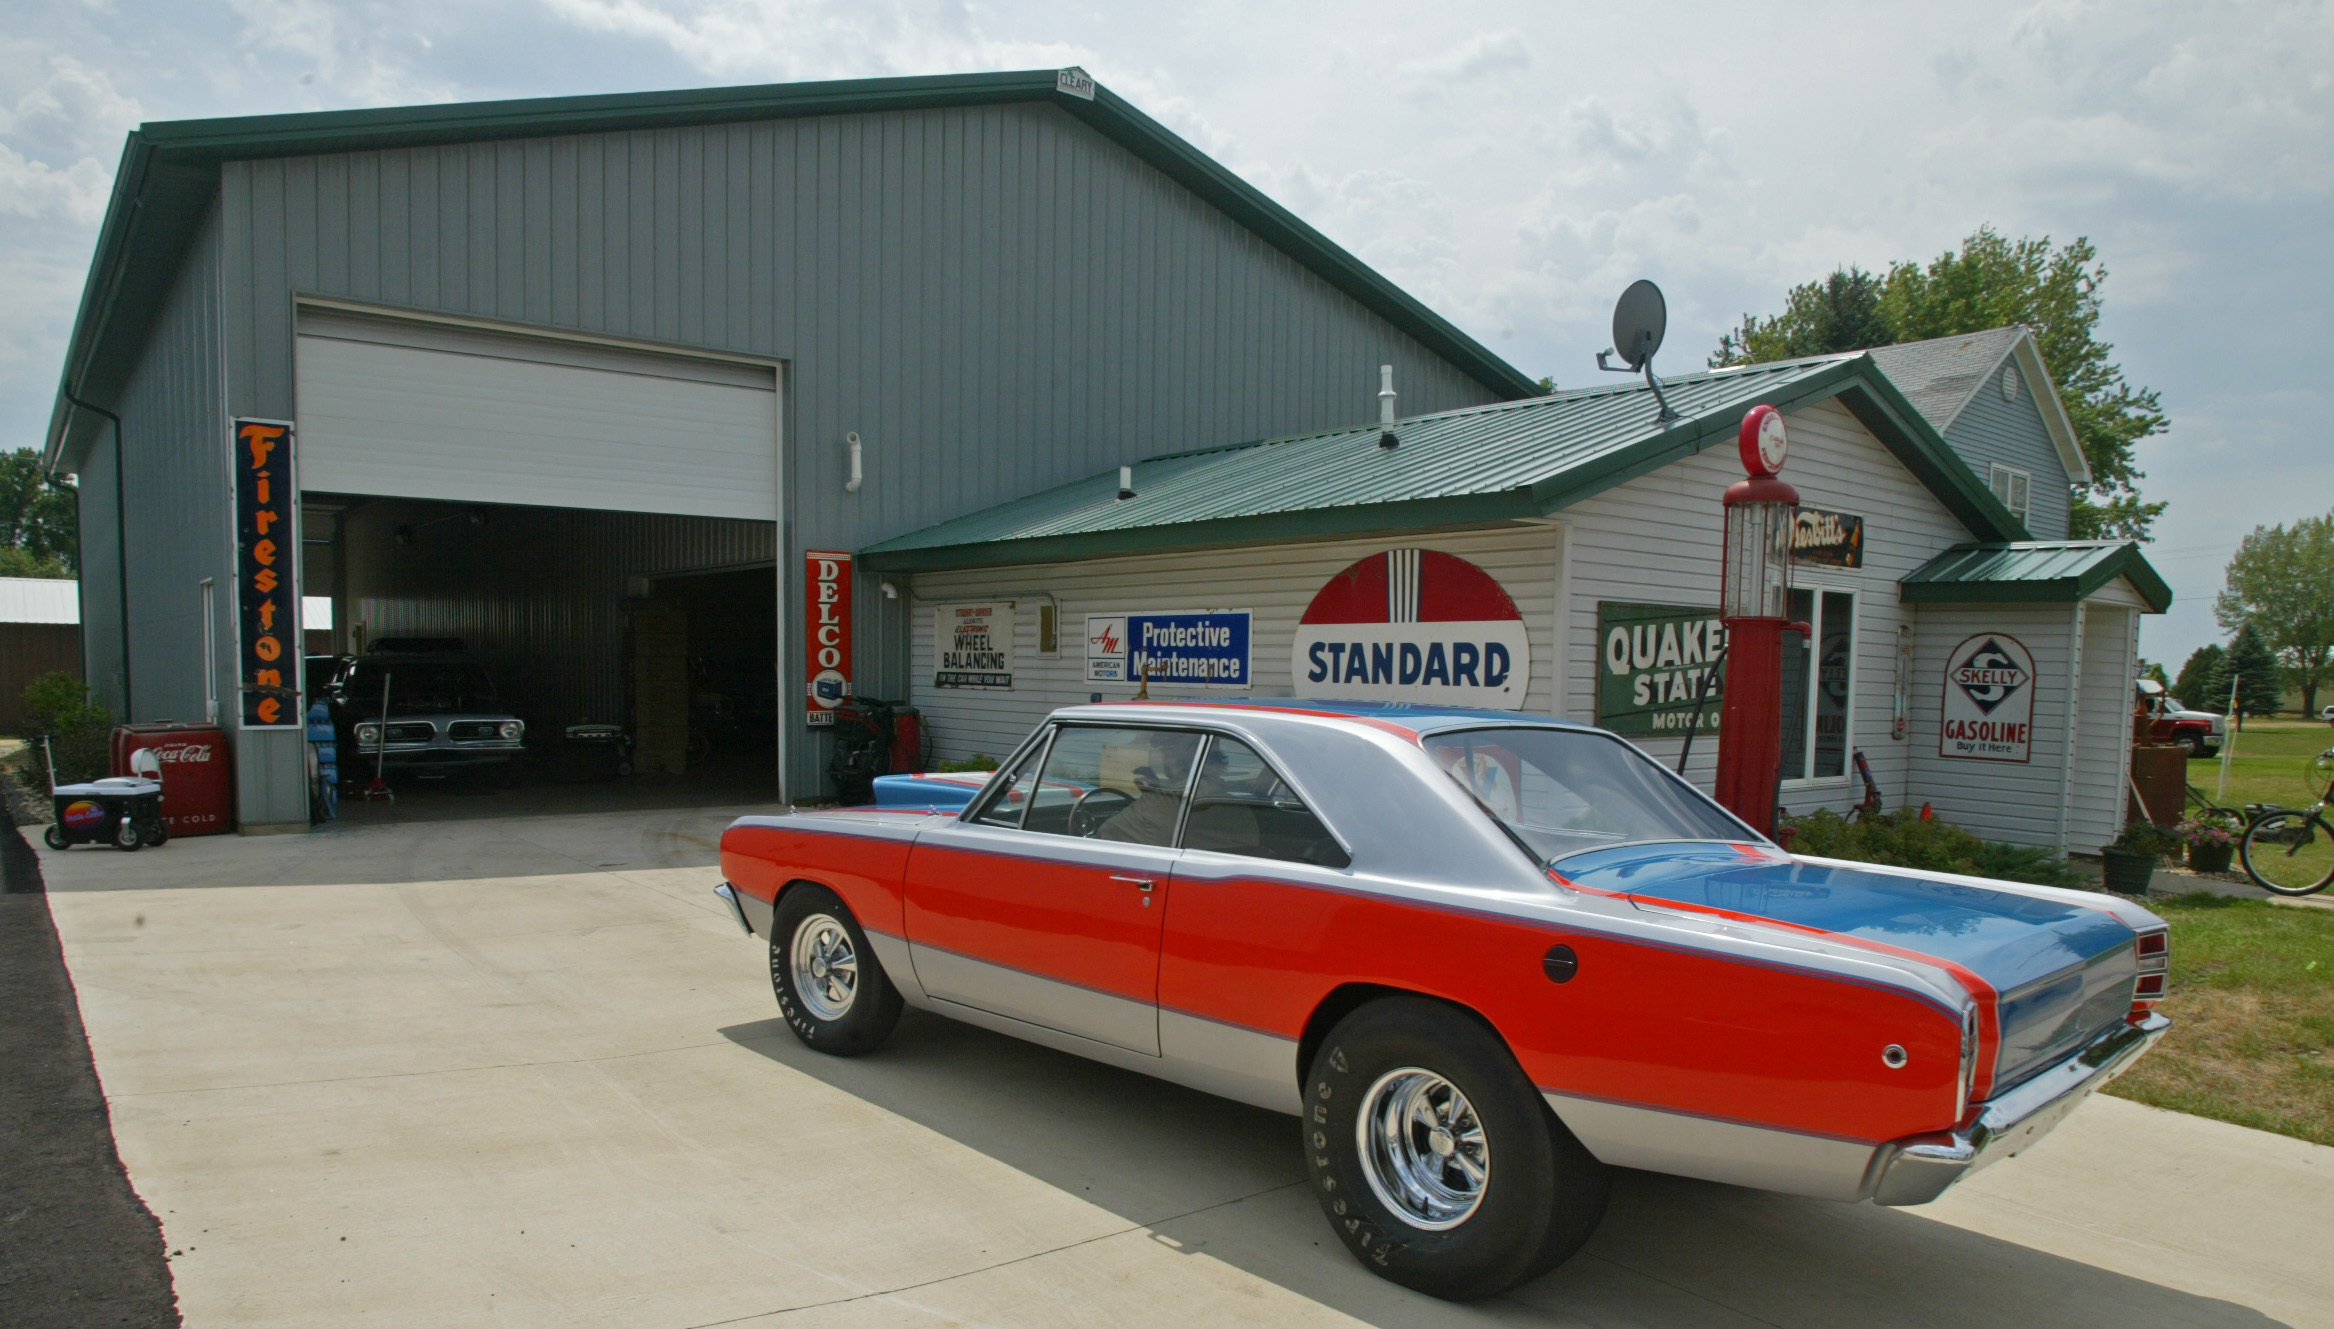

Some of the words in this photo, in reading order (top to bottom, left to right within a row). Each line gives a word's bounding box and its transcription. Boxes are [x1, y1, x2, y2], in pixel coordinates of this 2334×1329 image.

[1061, 73, 1093, 93] CLEARY
[238, 424, 285, 725] Firestone
[817, 560, 841, 668] DELCO
[954, 635, 993, 651] WHEEL
[1142, 621, 1231, 648] Protective
[1606, 619, 1729, 675] QUAKE
[943, 652, 1005, 670] BALANCING
[1092, 661, 1121, 669] AMERICAN
[1133, 650, 1241, 679] Maintenance
[1307, 641, 1511, 688] STANDARD
[1093, 669, 1118, 678] MOTORS
[1959, 668, 2018, 685] SKELLY
[1945, 719, 2027, 744] GASOLINE
[1956, 741, 1976, 753] Buy
[1988, 742, 2012, 753] Here
[183, 814, 217, 824] COLD
[1313, 1082, 1391, 1267] Firestone
